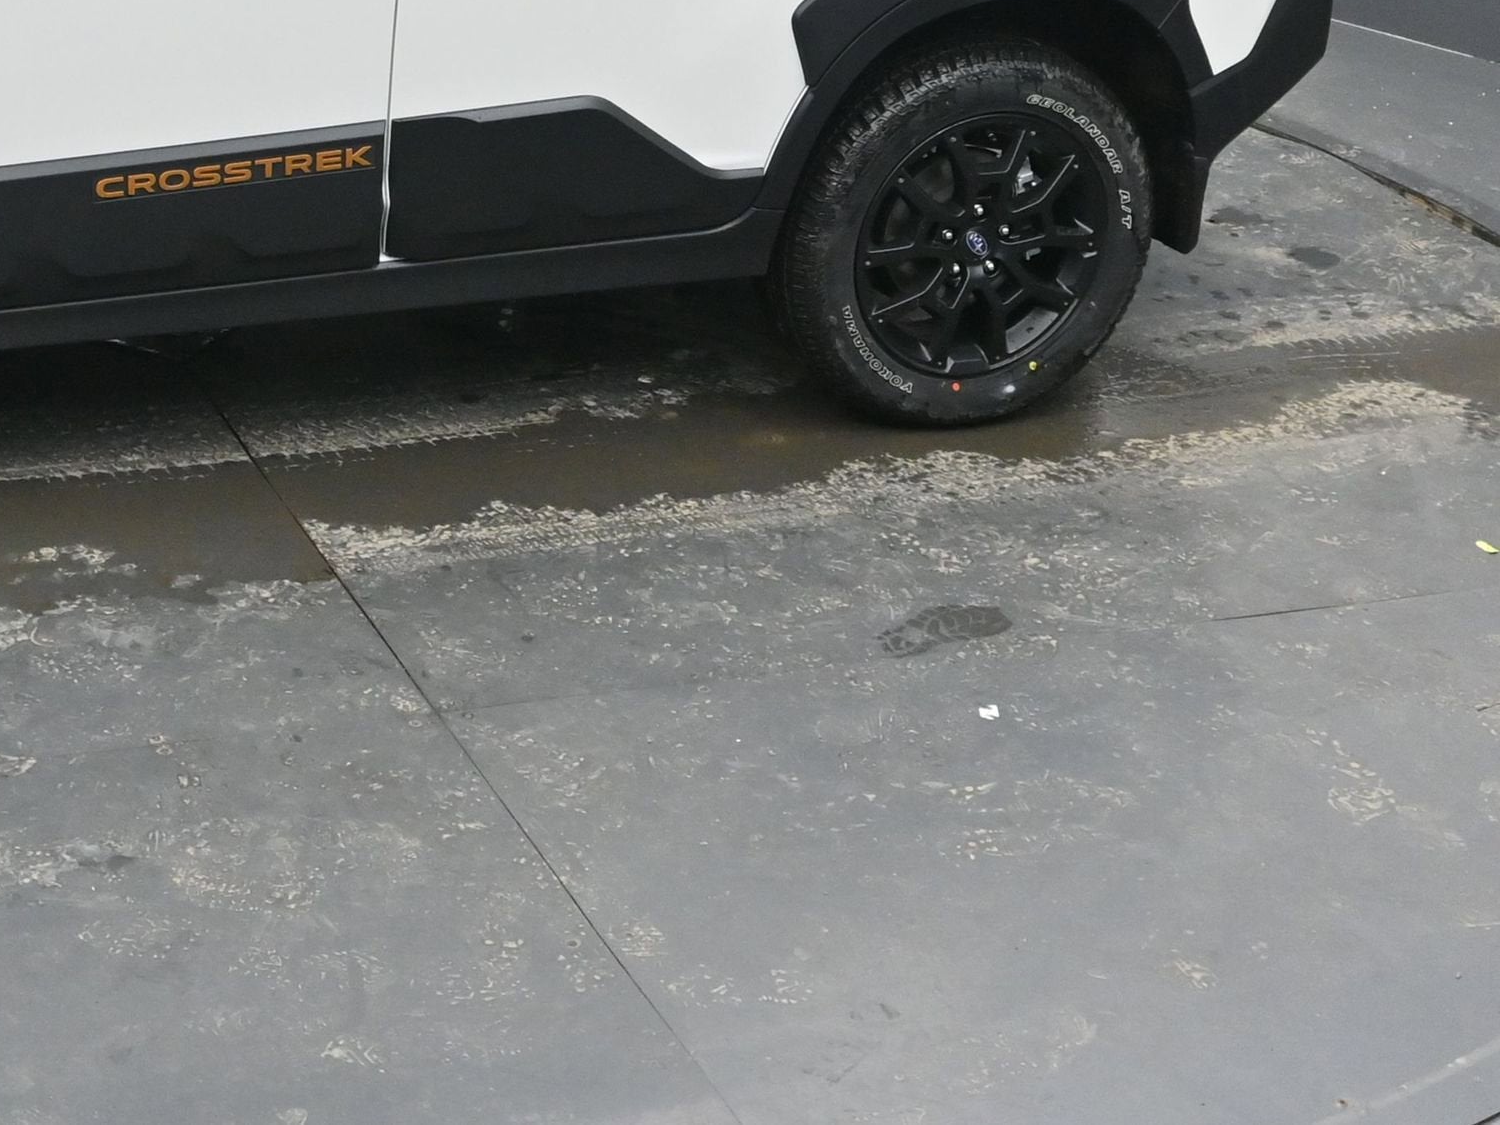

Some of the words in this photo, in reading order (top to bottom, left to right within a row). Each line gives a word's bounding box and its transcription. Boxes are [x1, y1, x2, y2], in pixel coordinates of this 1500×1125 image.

[95, 145, 372, 199] CROSSTREK
[1026, 94, 1124, 175] GEOLANDAR
[1118, 189, 1133, 230] A/T
[842, 304, 914, 394] YOKOHAMA
